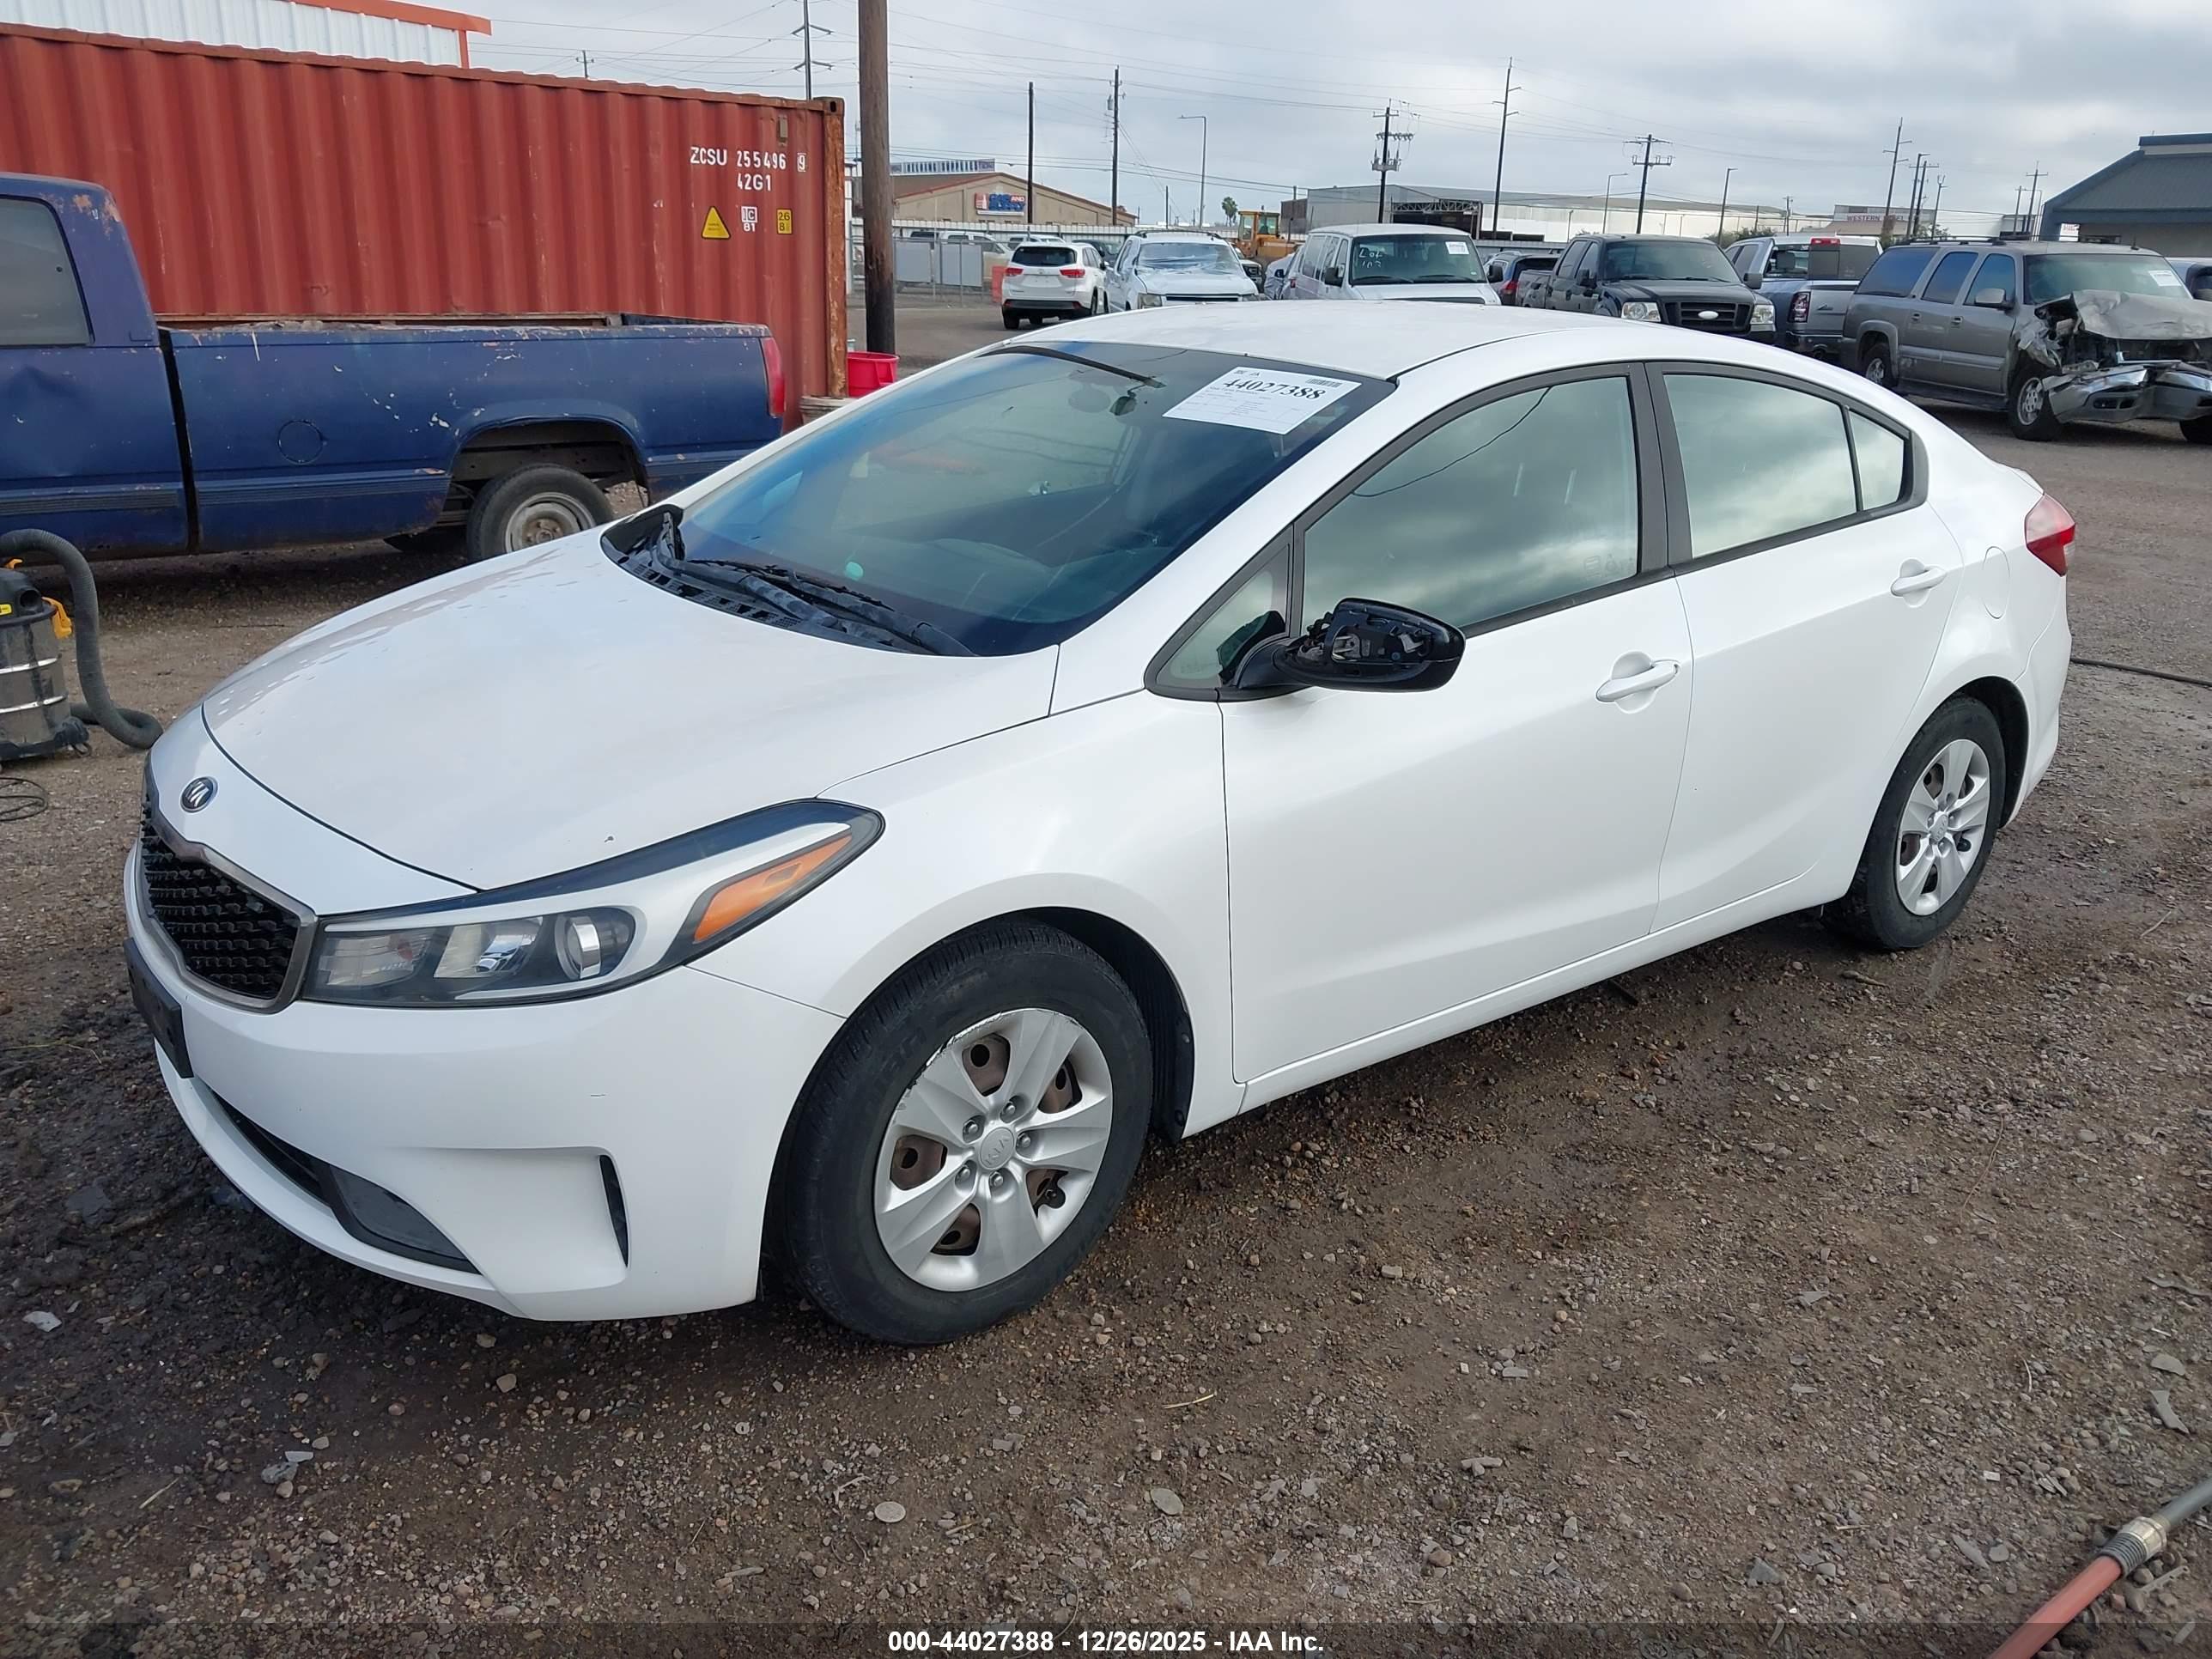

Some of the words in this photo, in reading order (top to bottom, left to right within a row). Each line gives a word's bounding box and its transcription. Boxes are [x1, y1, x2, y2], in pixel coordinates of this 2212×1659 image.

[690, 147, 727, 165] ZCSU
[737, 150, 787, 169] 255496
[737, 173, 772, 191] 42G1
[744, 222, 756, 232] 81
[1223, 379, 1327, 400] 44027388
